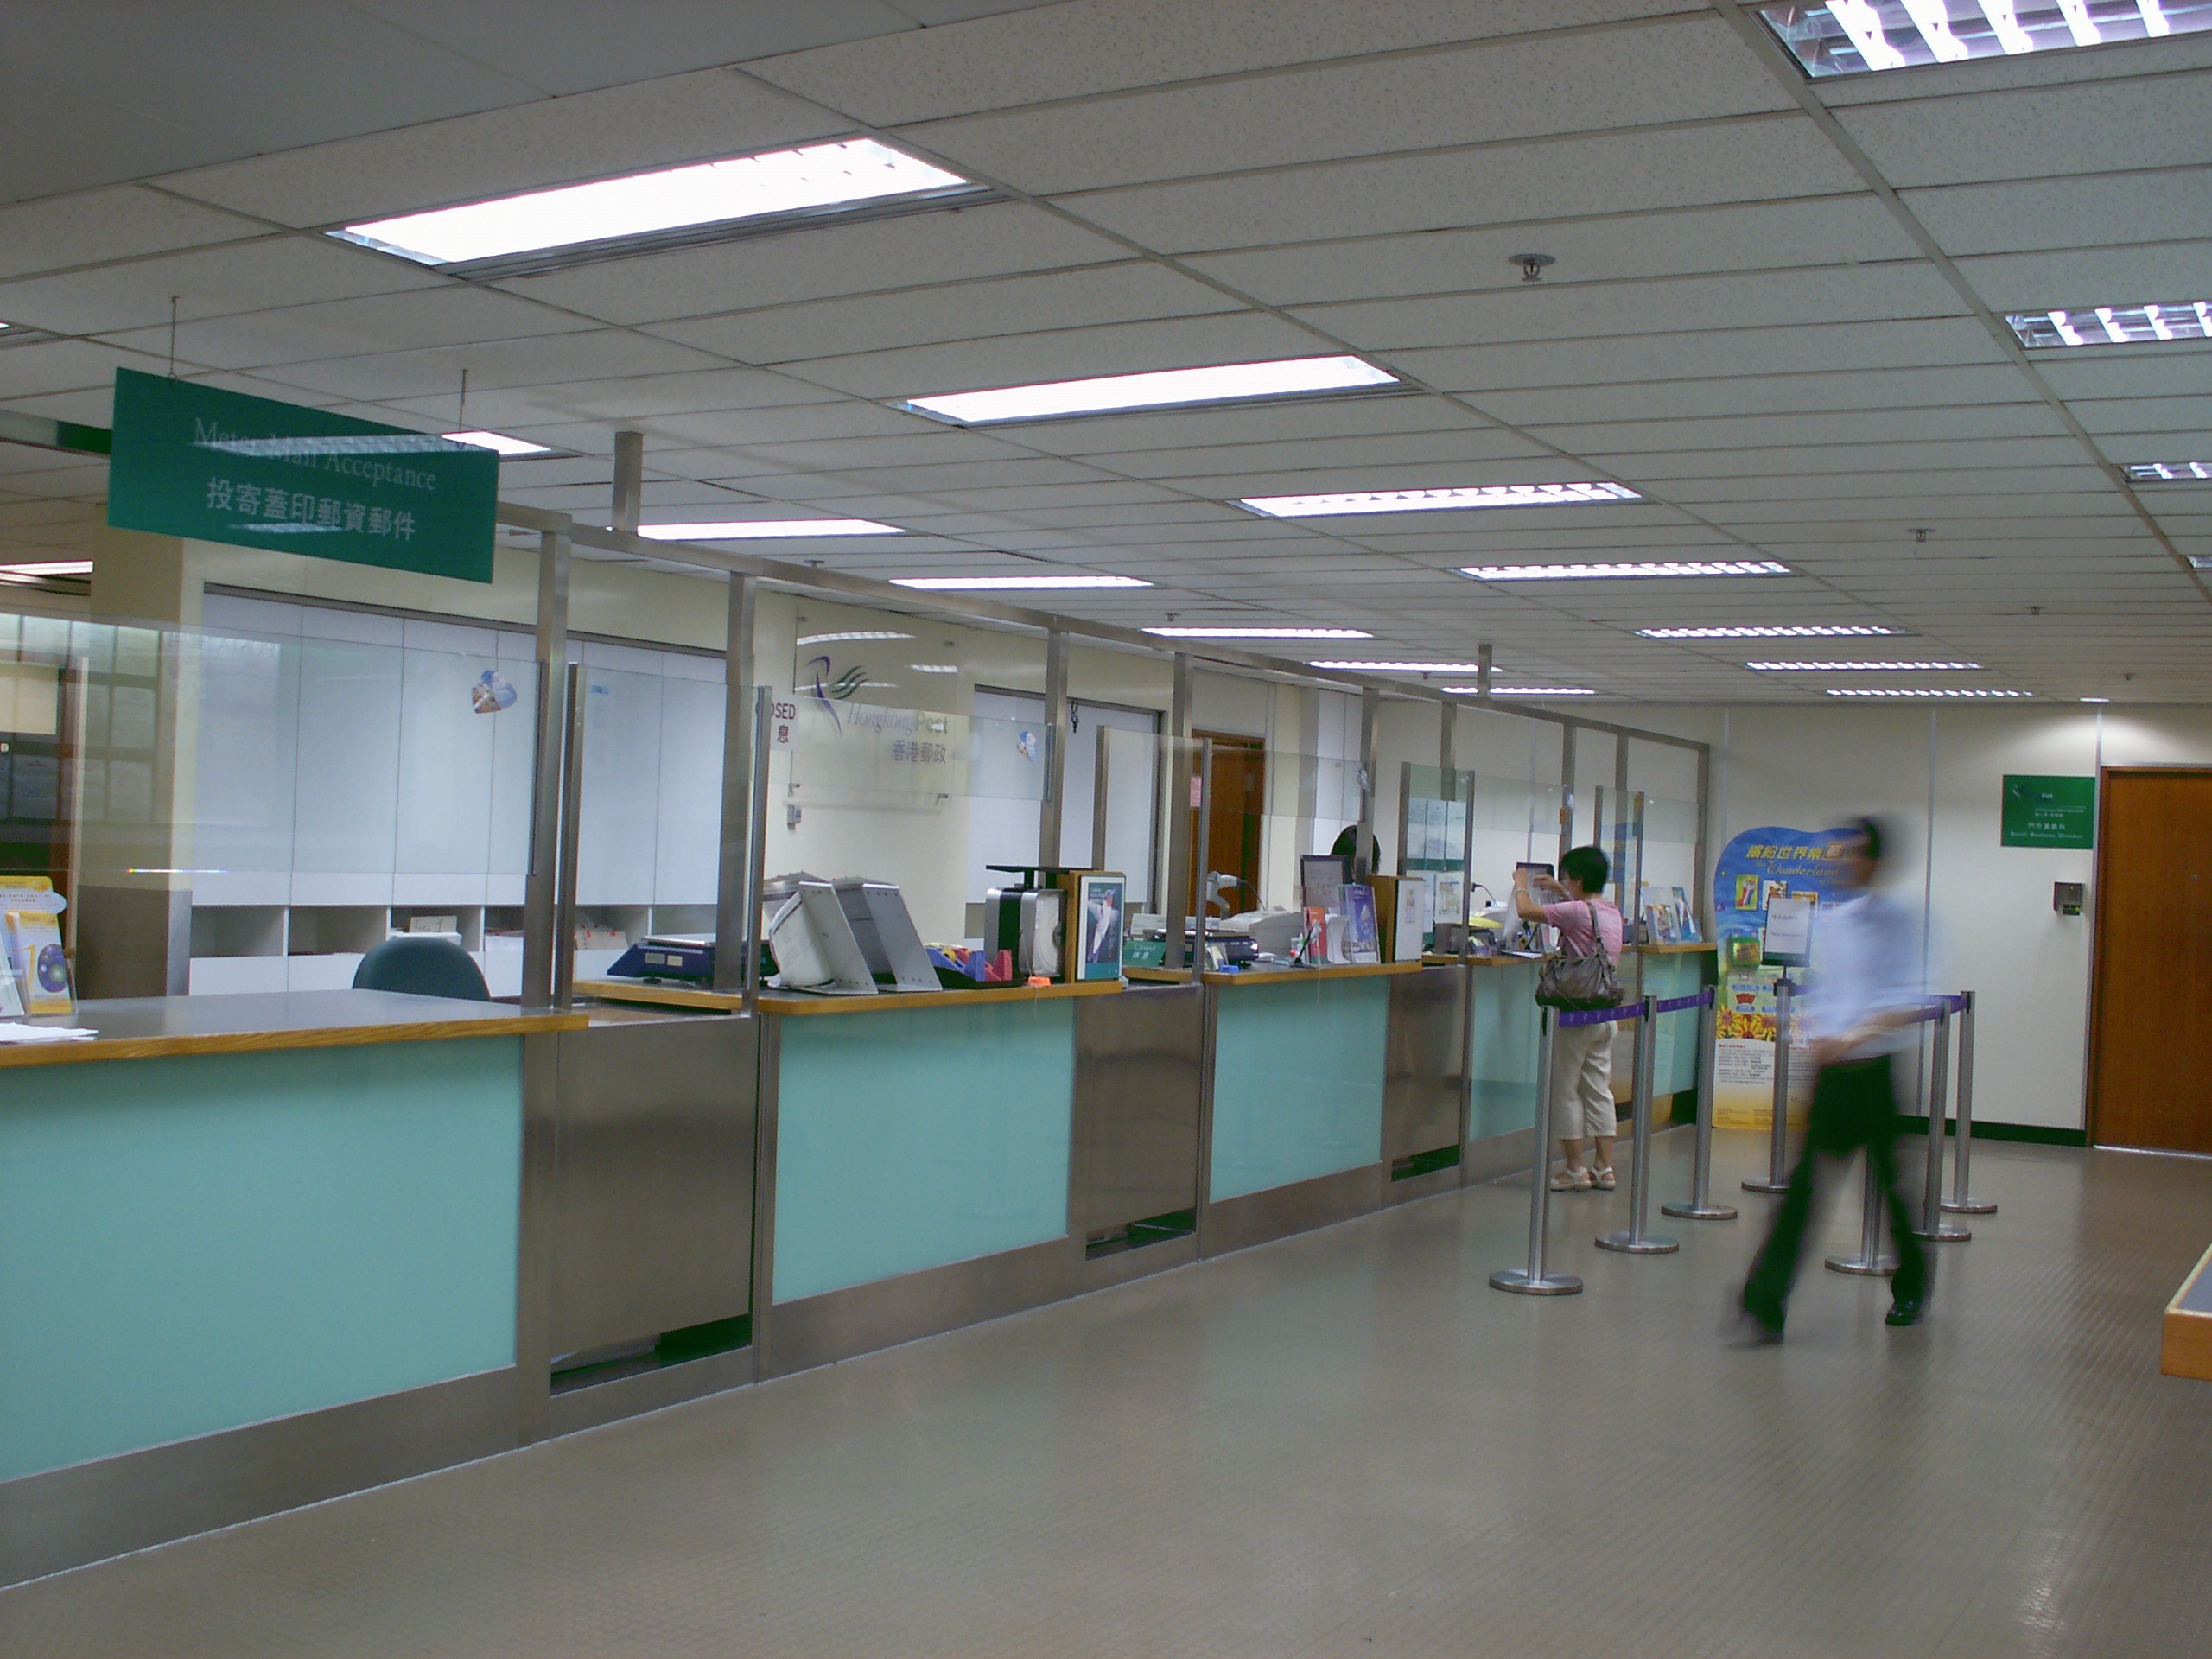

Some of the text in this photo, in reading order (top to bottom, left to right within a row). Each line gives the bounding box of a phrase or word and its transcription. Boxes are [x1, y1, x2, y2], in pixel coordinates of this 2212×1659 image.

[269, 433, 318, 470] ail
[324, 448, 436, 492] Acceptance
[206, 476, 416, 542] 投寄蓋印郵資郵件
[893, 740, 947, 765] 香港郵政
[1766, 860, 1840, 877] Wonderland
